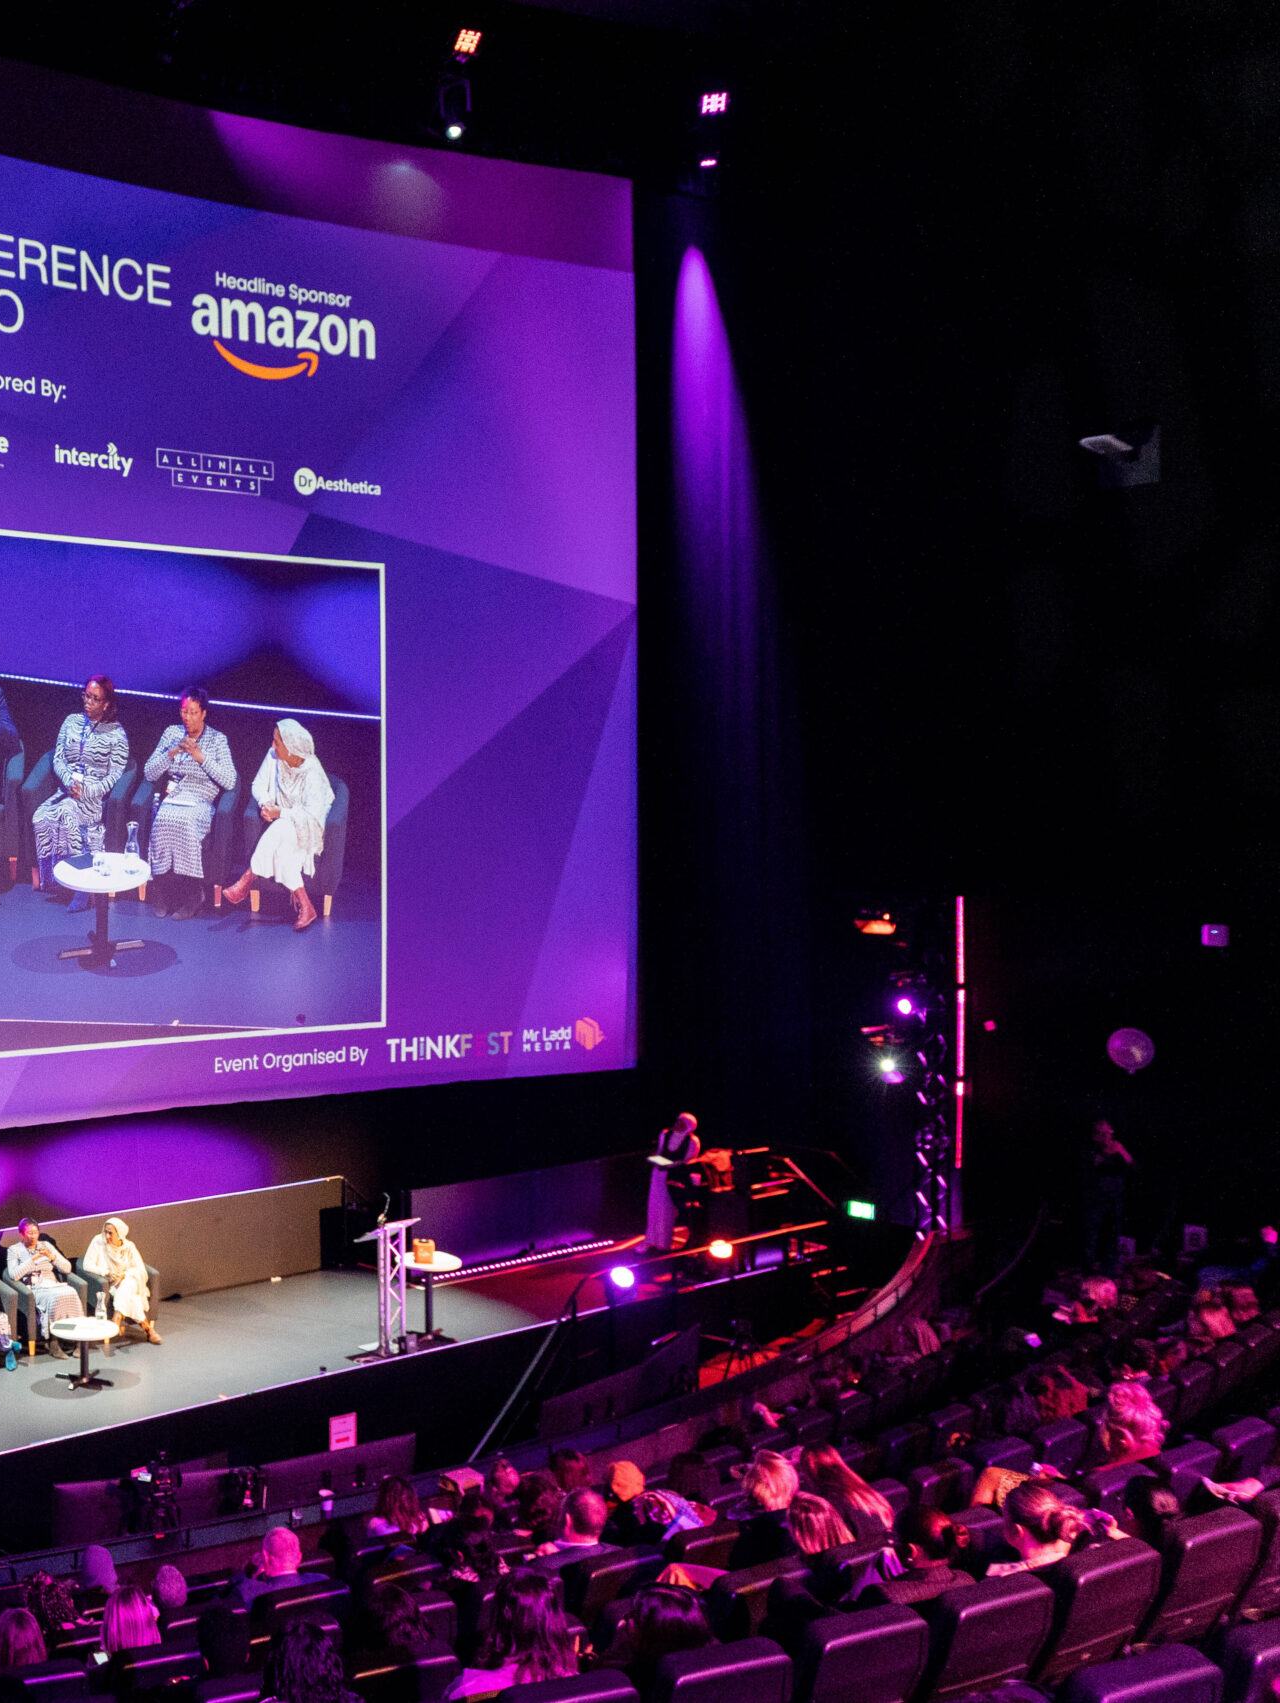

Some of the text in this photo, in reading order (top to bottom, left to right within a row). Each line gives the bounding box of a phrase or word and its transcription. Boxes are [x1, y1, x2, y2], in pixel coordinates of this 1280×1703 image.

[215, 271, 352, 307] Headline Sponsor
[191, 293, 376, 360] amazon
[40, 379, 67, 403] By:
[54, 443, 133, 477] intercity
[161, 454, 269, 475] ALL IN ALL
[176, 473, 256, 491] EVENTS
[298, 473, 382, 496] Dr Aesthetica
[522, 1026, 572, 1043] Mr Ladd
[522, 1041, 572, 1052] MEDIA
[214, 1046, 369, 1074] Event Organised By
